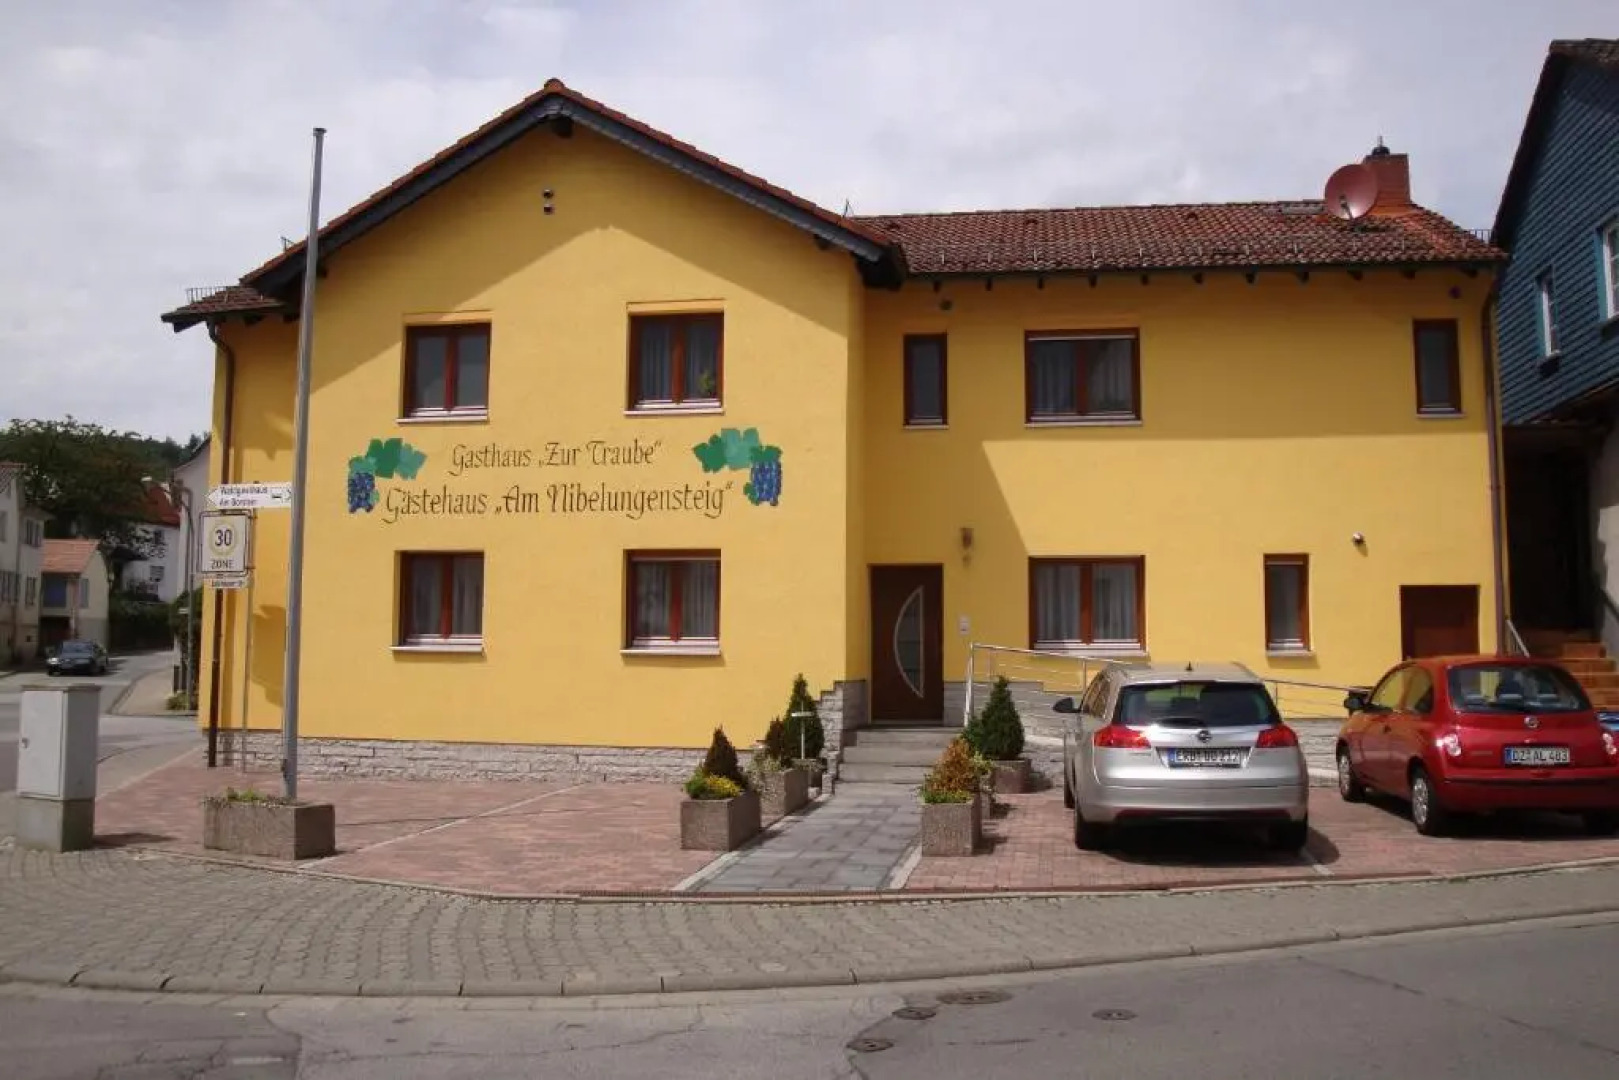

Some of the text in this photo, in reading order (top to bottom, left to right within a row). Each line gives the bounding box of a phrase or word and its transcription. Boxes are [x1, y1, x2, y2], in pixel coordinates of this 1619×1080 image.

[447, 442, 532, 477] Gasthaus
[381, 484, 488, 524] Gästehaus
[215, 529, 233, 546] 30
[211, 559, 235, 569] ZONE
